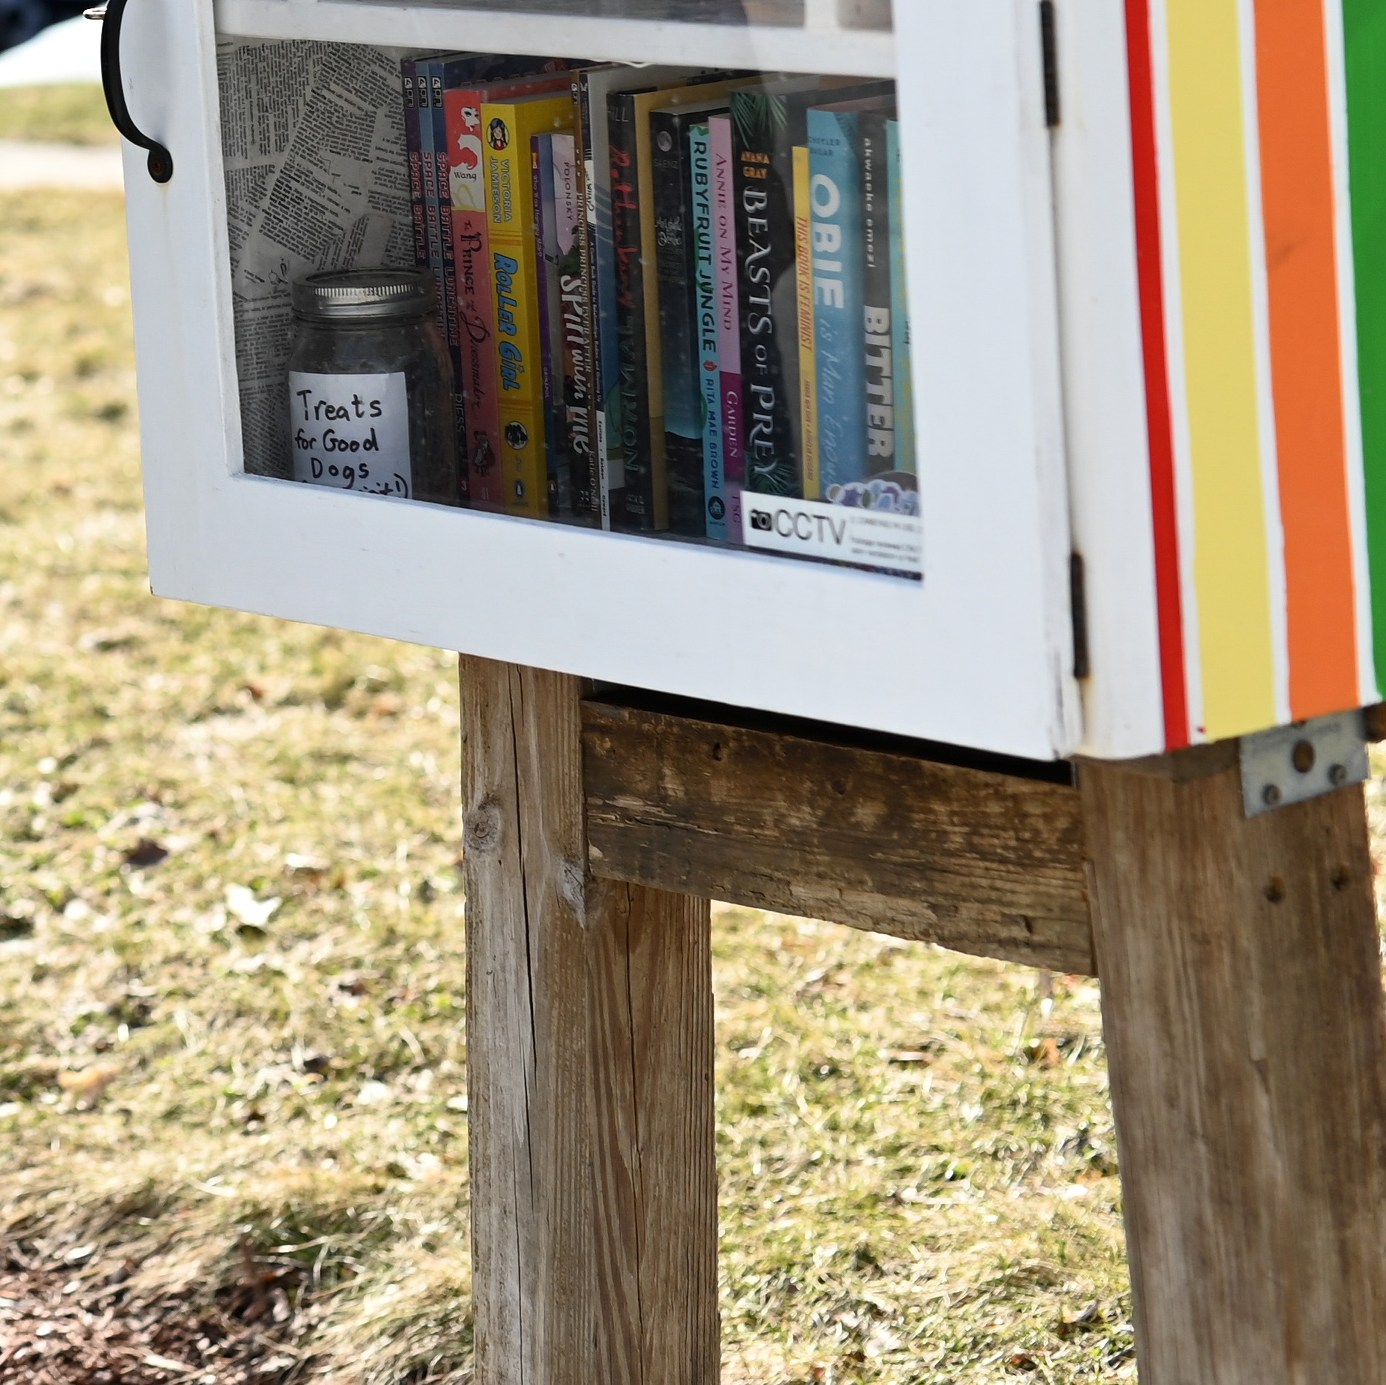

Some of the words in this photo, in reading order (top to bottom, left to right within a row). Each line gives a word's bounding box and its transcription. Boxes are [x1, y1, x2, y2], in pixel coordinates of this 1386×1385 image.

[409, 152, 423, 199] SPACE
[423, 152, 435, 197] SPACE
[437, 152, 451, 199] SPACE
[454, 171, 477, 181] Wang
[490, 155, 502, 223] JAMIESON
[501, 159, 512, 222] VICTORIA
[564, 161, 572, 220] POLONSKY
[743, 166, 768, 179] GRAY
[864, 138, 874, 212] akwaeke
[577, 192, 585, 245] PRINCESS
[694, 141, 711, 265] RUBYFRUIT
[413, 205, 426, 259] BATTLE
[427, 205, 439, 259] BATTLE
[440, 205, 453, 260] BATTLE
[797, 216, 809, 246] THIS
[811, 174, 844, 308] OBIE
[867, 218, 876, 268] emezi
[743, 186, 773, 334] BEASTS
[797, 245, 810, 281] BOOK
[444, 267, 460, 347] LUNCHTIME
[494, 253, 518, 336] ROLLER
[700, 269, 716, 353] JUNGLE
[715, 153, 726, 209] ANNIE
[721, 281, 733, 331] MIND
[727, 391, 738, 458] GARDEN
[799, 280, 810, 295] IS
[800, 293, 812, 352] FEMINIST
[819, 319, 838, 341] is
[460, 311, 490, 414] Dressmaker
[571, 349, 587, 400] with
[754, 344, 767, 375] OF
[822, 351, 841, 404] Man
[864, 305, 894, 457] BITTER
[297, 390, 382, 421] Treats
[706, 378, 715, 404] RITA
[295, 428, 317, 450] for
[323, 427, 379, 452] Good
[708, 411, 717, 437] MAE
[749, 383, 776, 478] PREY
[311, 457, 369, 489] Dogs
[709, 443, 720, 489] BROWN
[776, 509, 846, 545] CCTV
